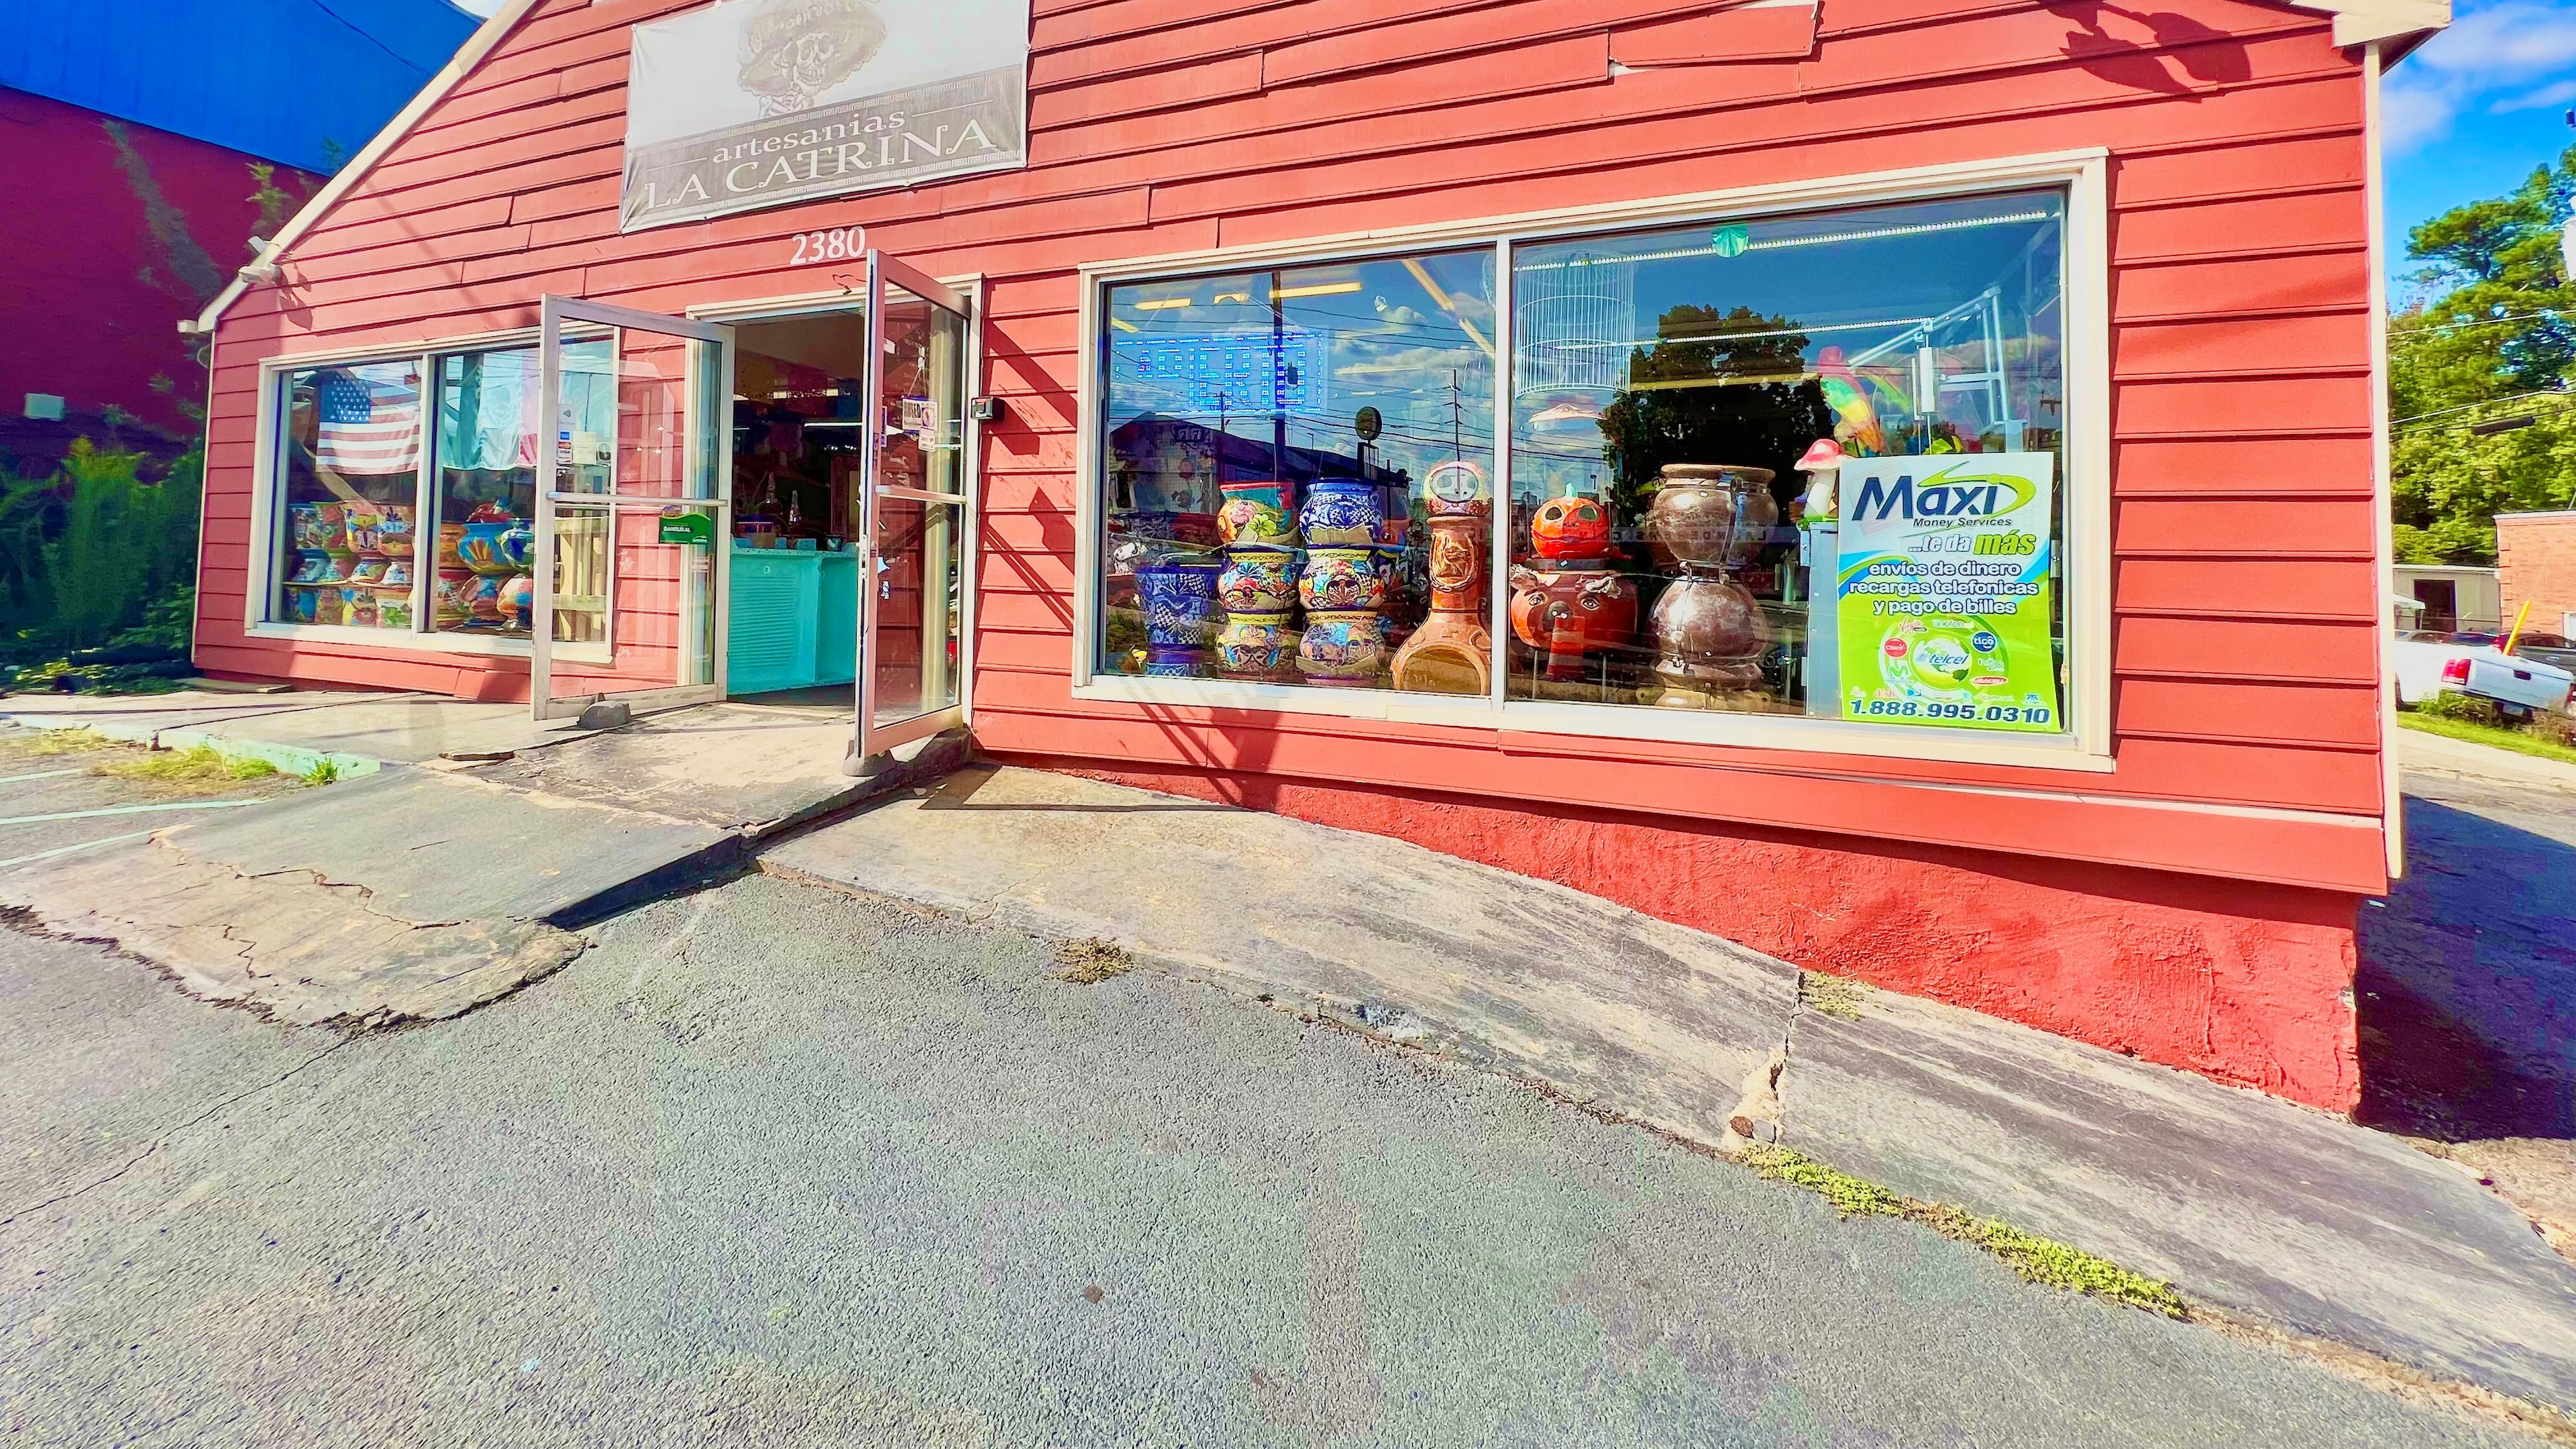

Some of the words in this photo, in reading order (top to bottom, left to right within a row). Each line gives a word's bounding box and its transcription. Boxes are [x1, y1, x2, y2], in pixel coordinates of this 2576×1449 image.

[712, 111, 906, 164] artesanias
[644, 172, 711, 209] LA
[724, 118, 998, 194] CATRINA
[788, 225, 866, 266] 2380
[1851, 475, 1998, 521] Maxi
[1913, 517, 1954, 528] Money
[1957, 517, 2012, 527] Services
[1944, 534, 1972, 553] da
[1972, 529, 2037, 555] más
[1868, 561, 1929, 577] envíos
[1929, 560, 1956, 576] de
[1957, 560, 2022, 576] dinero
[1849, 582, 1931, 597] recargas
[1933, 579, 2039, 596] telefonicas
[1873, 600, 1886, 615] y
[1887, 600, 1936, 616] pago
[1937, 598, 1962, 614] de
[1965, 598, 2017, 614] billes
[1929, 653, 1970, 665] telcel
[1850, 699, 2051, 724] 1.888.995.0310
